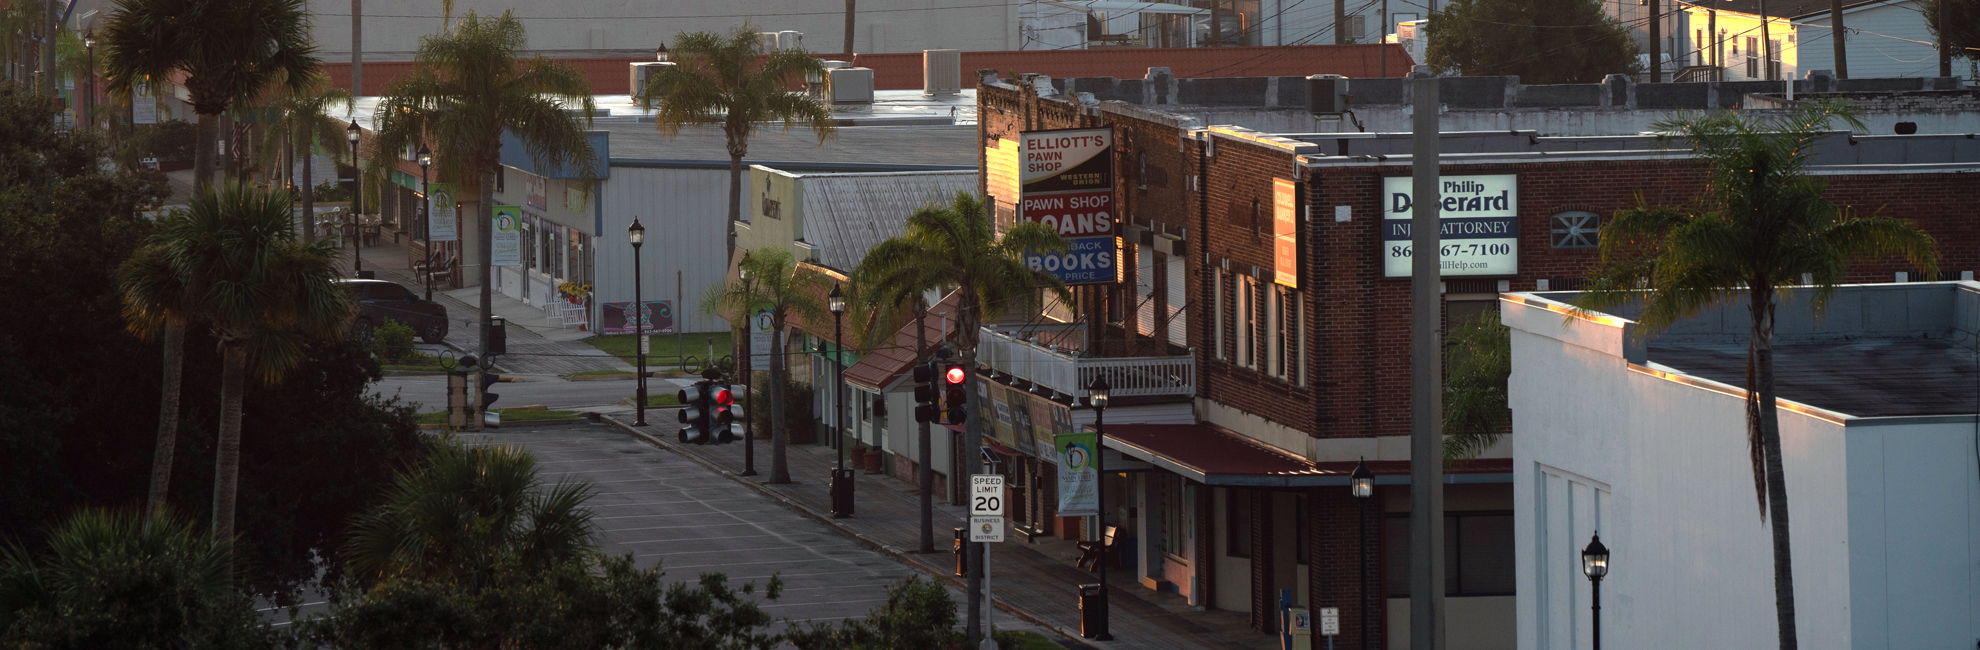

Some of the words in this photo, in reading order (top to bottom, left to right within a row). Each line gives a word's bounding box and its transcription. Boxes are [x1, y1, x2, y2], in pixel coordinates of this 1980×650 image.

[1027, 135, 1104, 150] ELLIOTT'S
[1027, 151, 1062, 162] PAWN
[1028, 162, 1062, 172] SHOP
[1060, 172, 1101, 180] WESTERN
[1443, 180, 1485, 195] Philip
[1024, 197, 1064, 211] PAWN
[1069, 195, 1109, 209] SHOP
[1439, 221, 1510, 234] ATTORNEY
[1391, 243, 1510, 258] 8667-7100
[1027, 251, 1111, 272] BOOKS
[1439, 260, 1488, 271] illHelp.com
[1065, 271, 1096, 281] PRICE
[974, 477, 1002, 485] SPEED
[975, 496, 1000, 511] 20
